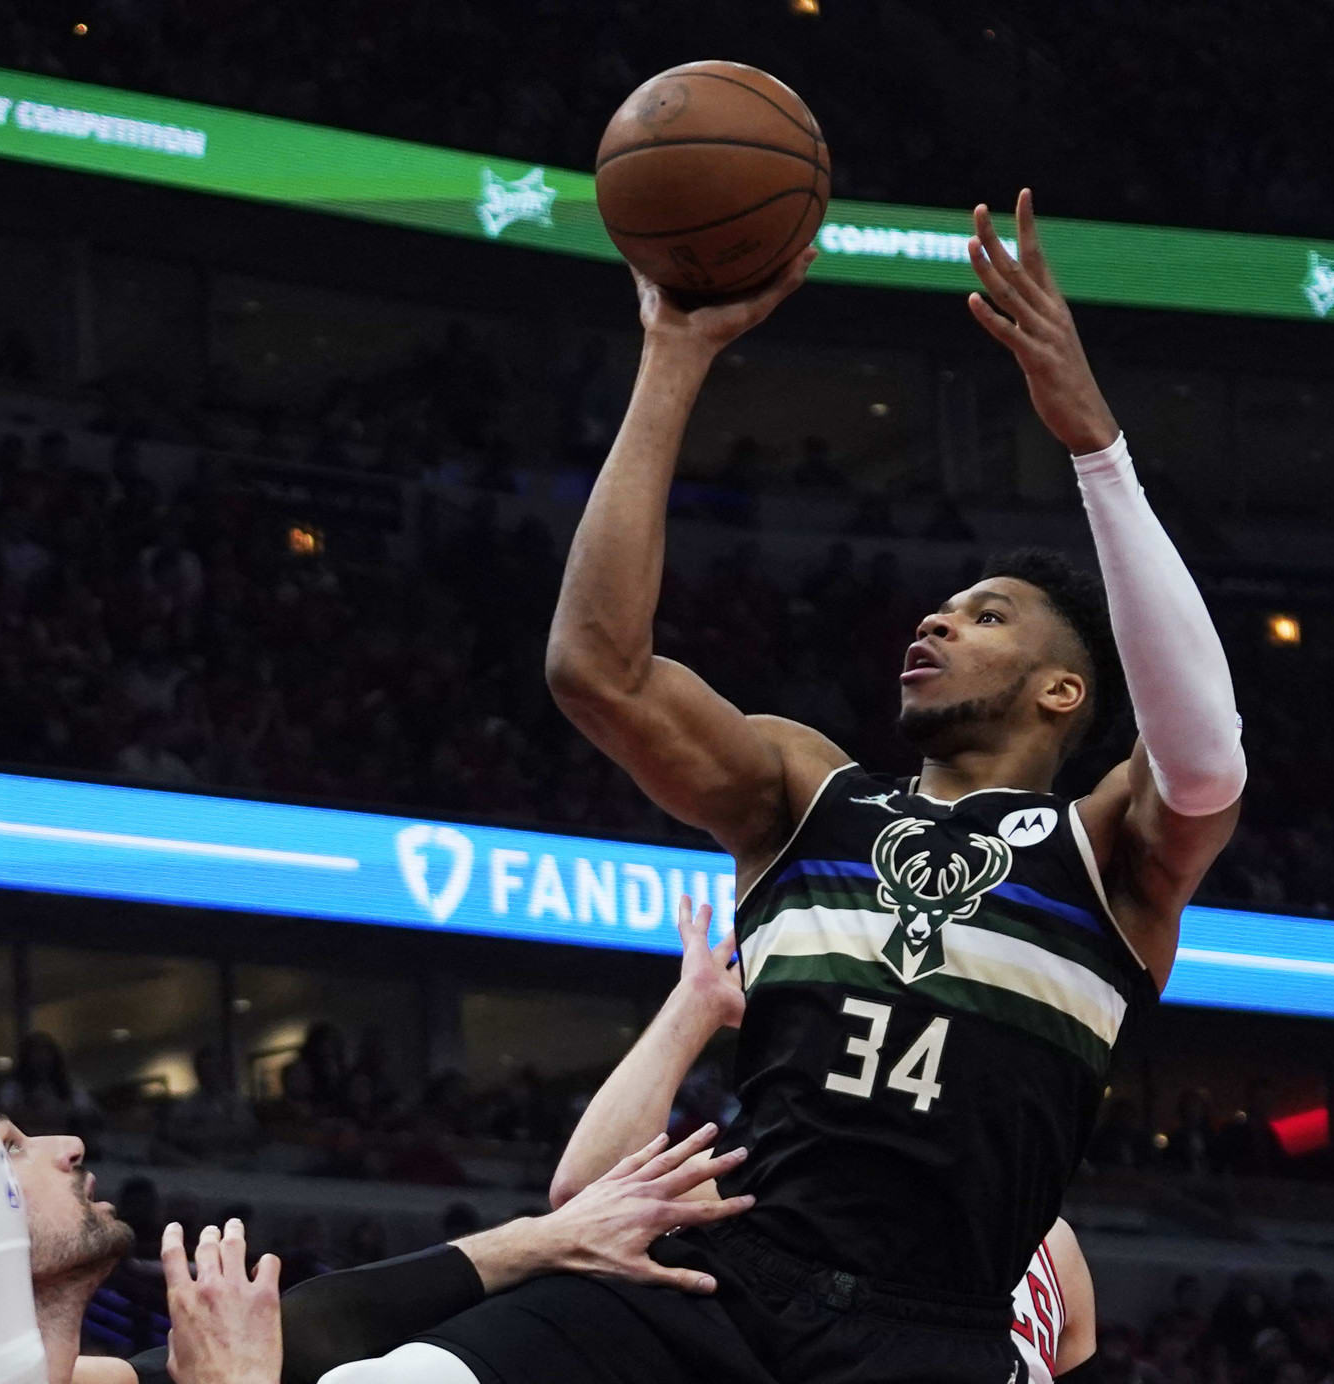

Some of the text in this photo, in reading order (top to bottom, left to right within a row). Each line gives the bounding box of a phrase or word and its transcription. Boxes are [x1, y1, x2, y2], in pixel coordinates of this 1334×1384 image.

[14, 99, 207, 158] COMPETITION
[820, 223, 1018, 264] COMPETITIN
[486, 847, 736, 938] FANDUE
[824, 996, 952, 1113] 34
